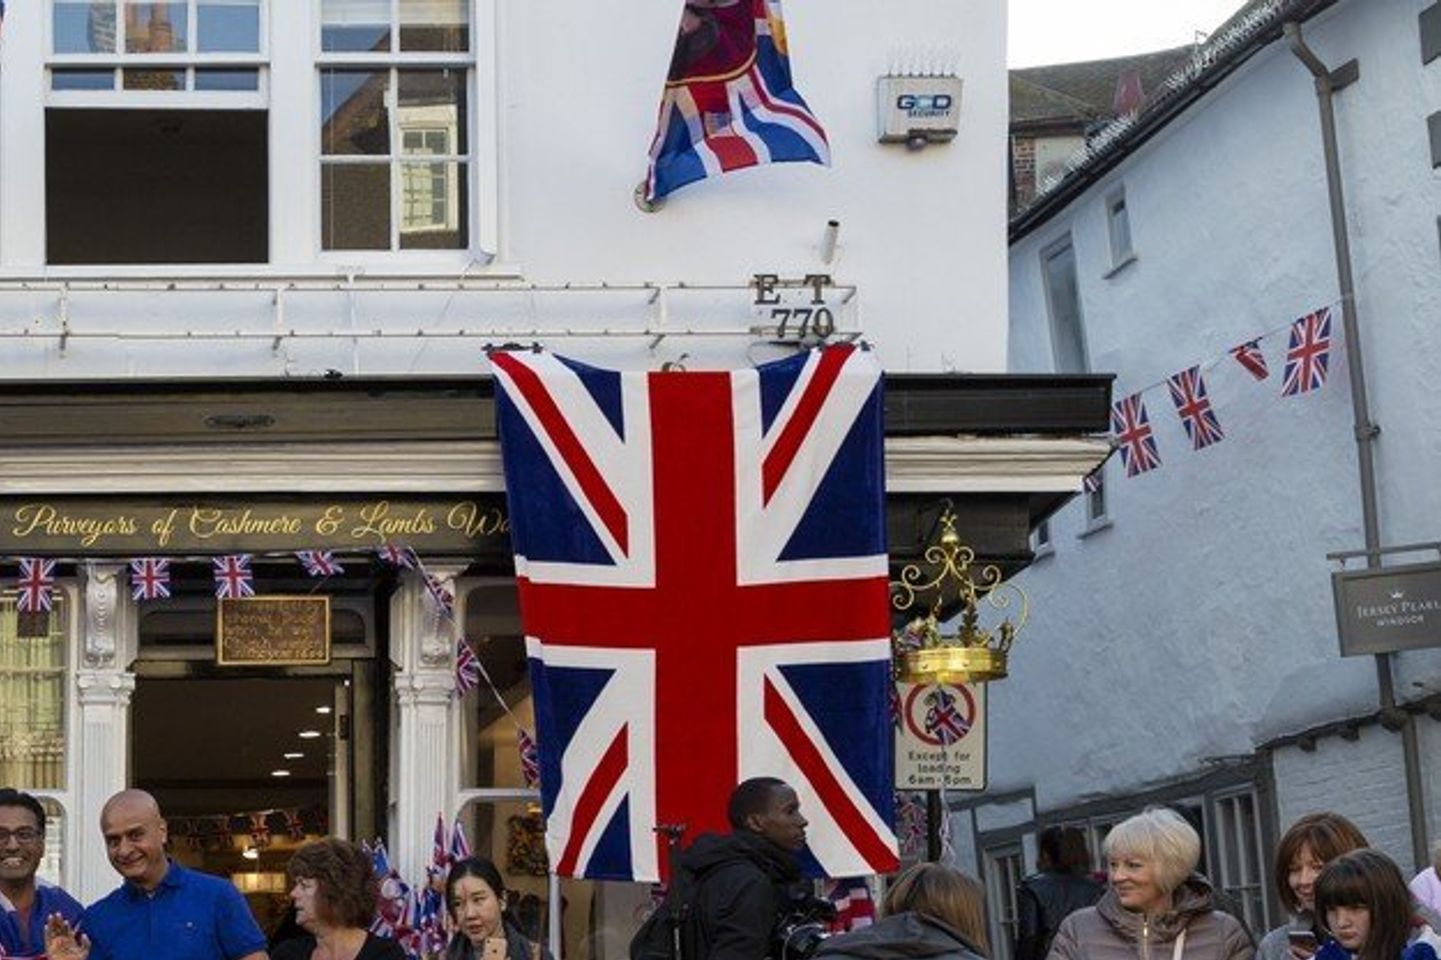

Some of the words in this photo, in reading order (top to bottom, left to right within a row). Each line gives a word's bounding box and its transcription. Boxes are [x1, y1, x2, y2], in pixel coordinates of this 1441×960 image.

[753, 274, 781, 305] E
[803, 274, 832, 305] T
[12, 503, 139, 547] Purveyors
[151, 508, 178, 547] of
[189, 504, 301, 539] Cashmere
[315, 504, 346, 536] &
[351, 500, 437, 543] Lambs
[1357, 604, 1398, 618] JERSEY
